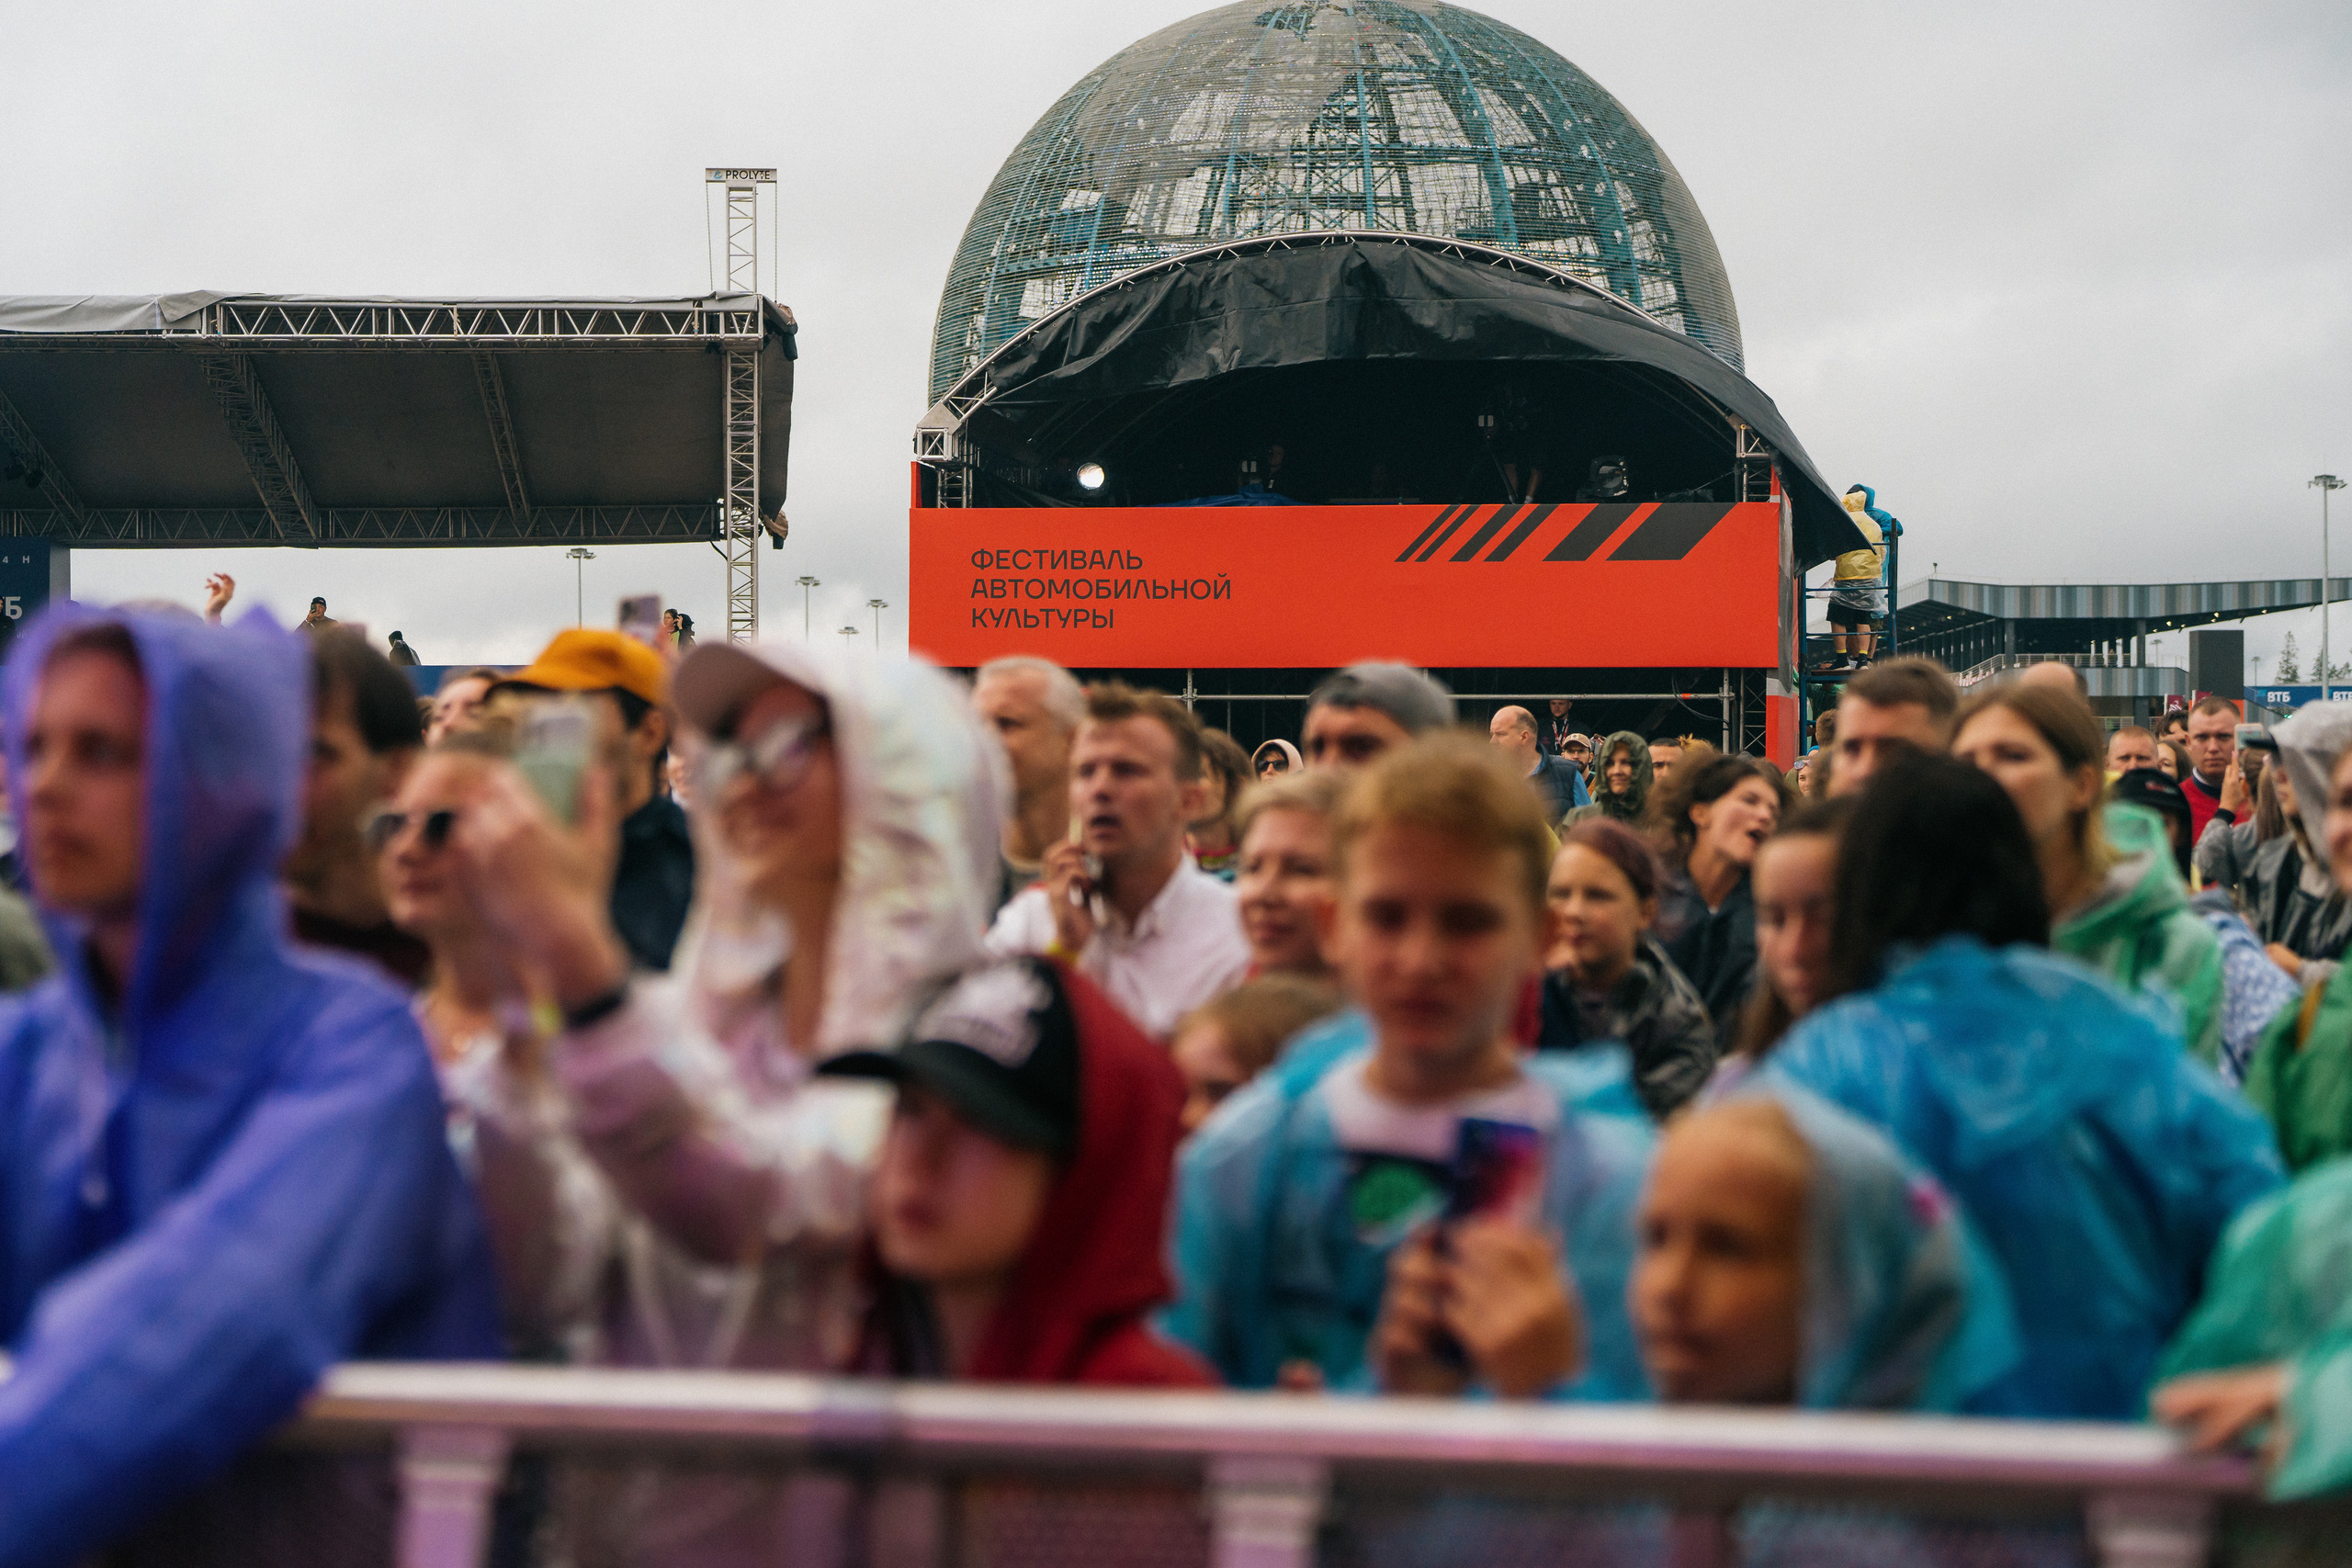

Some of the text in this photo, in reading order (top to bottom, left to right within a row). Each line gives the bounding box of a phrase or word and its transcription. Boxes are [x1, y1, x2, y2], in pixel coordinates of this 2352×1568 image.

[726, 170, 771, 180] PROLYTE
[970, 548, 1144, 570] ФЕСТИВАЛЬ
[970, 572, 1232, 600] АВТОМОБИЛЬНОЙ
[2, 596, 23, 620] Б
[971, 607, 1114, 629] КУЛЬТУРЫ
[2267, 691, 2291, 703] ВТБ
